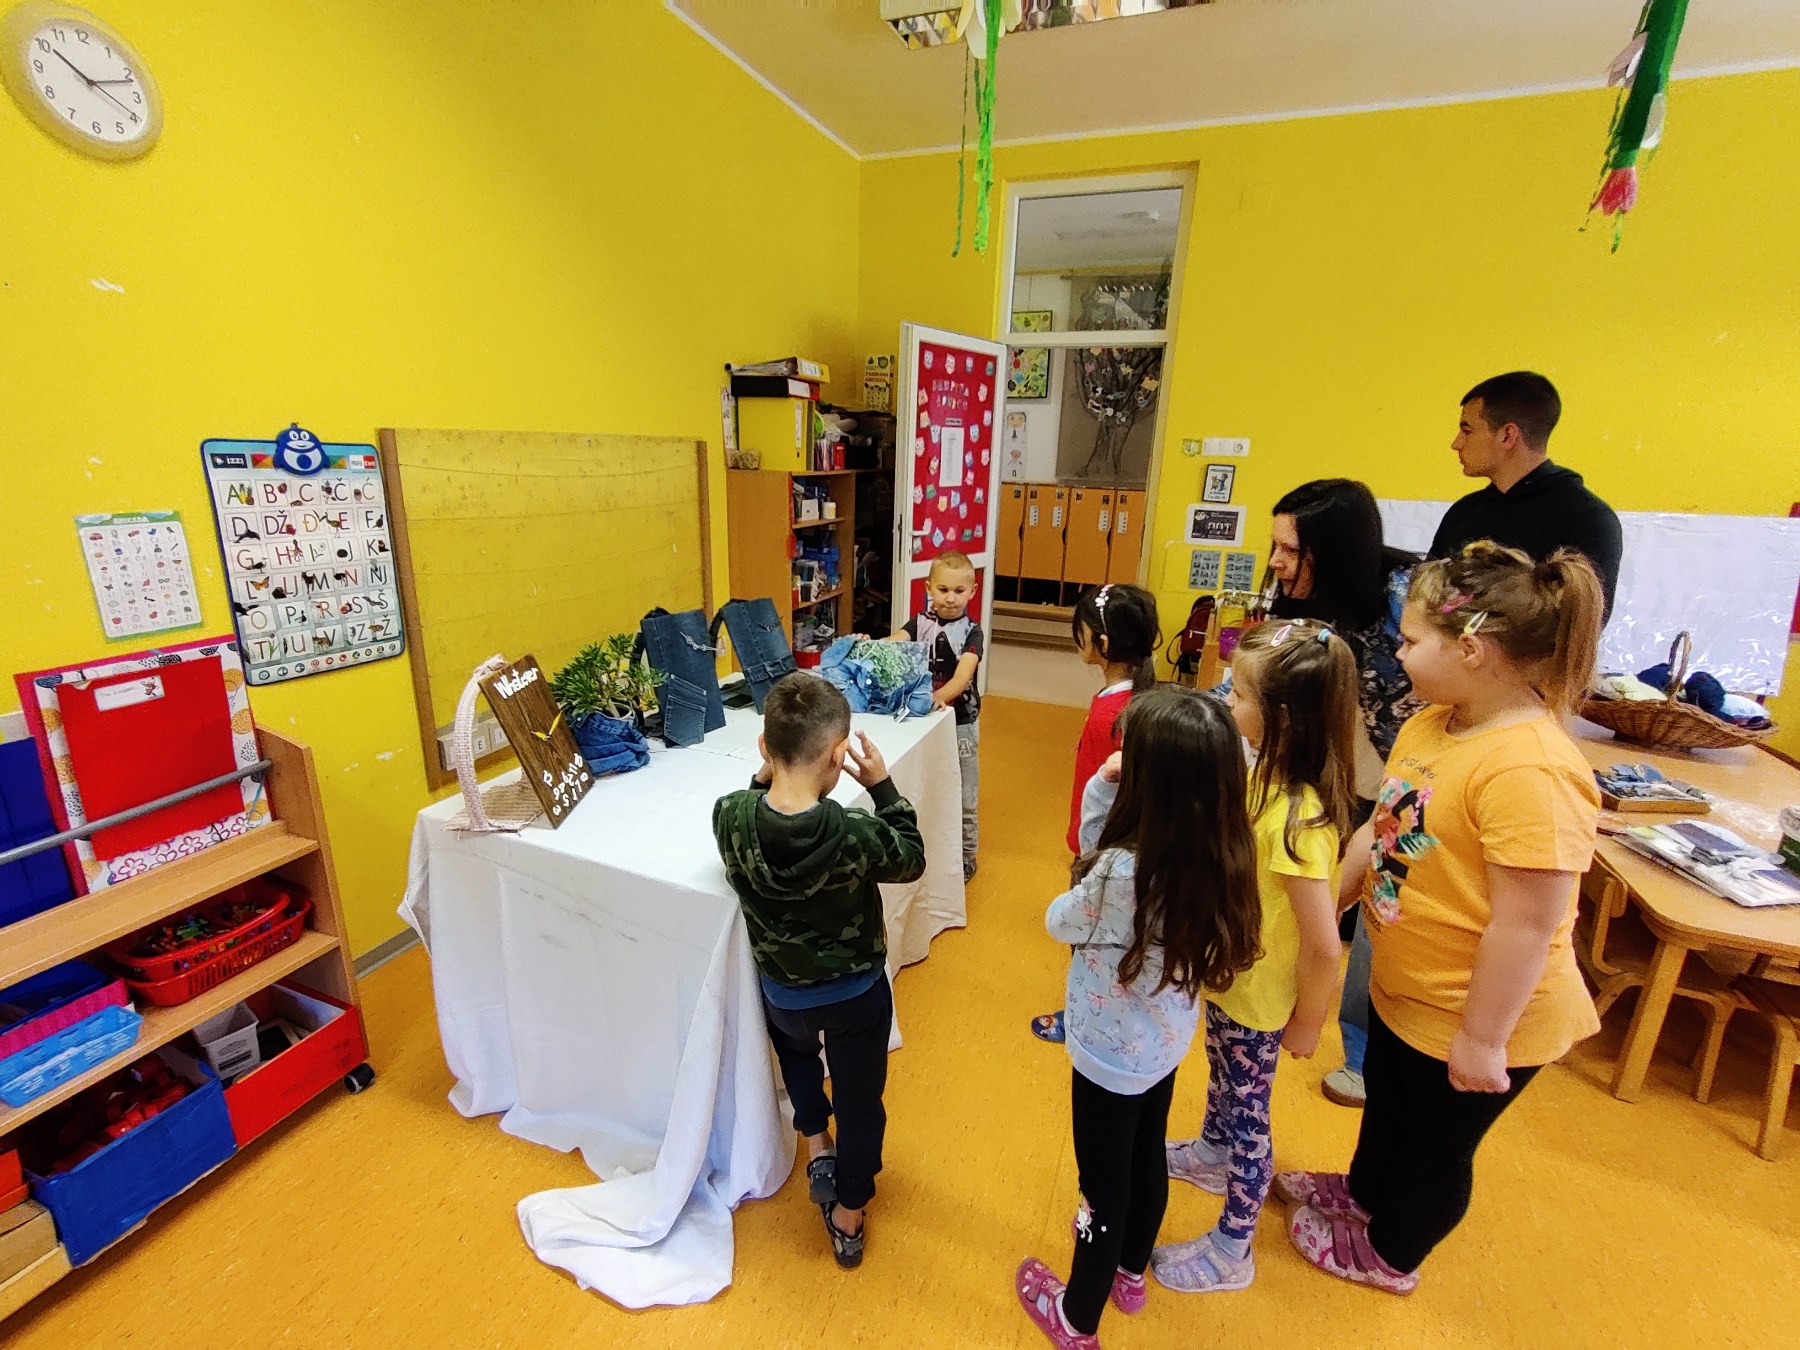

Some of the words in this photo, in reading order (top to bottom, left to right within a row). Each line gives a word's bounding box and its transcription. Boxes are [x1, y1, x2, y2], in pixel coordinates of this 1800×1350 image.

[51, 28, 66, 43] 11
[76, 28, 90, 45] 12
[35, 37, 51, 53] 10
[104, 47, 111, 58] 1
[33, 59, 43, 73] 9
[123, 67, 133, 80] 2
[45, 85, 55, 99] 8
[133, 91, 141, 104] 3
[67, 107, 76, 120] 7
[92, 121, 102, 134] 6
[115, 122, 124, 134] 5
[227, 484, 243, 505] A
[263, 484, 278, 504] B
[300, 484, 313, 503] C
[334, 477, 348, 501] Č
[362, 477, 375, 500] Ć
[232, 516, 248, 537] D
[264, 510, 288, 535] DŽ
[303, 513, 318, 533] Đ
[338, 512, 350, 530] E
[366, 510, 374, 528] F
[236, 549, 254, 570] G
[275, 545, 292, 565] H
[347, 541, 353, 561] J
[367, 539, 379, 556] K
[245, 580, 258, 600] L
[283, 575, 298, 598] LJ
[312, 572, 330, 592] M
[345, 568, 358, 587] N
[371, 565, 387, 585] NJ
[250, 610, 268, 630] O
[285, 605, 296, 624] P
[319, 601, 334, 618] R
[352, 596, 363, 614] S
[377, 588, 388, 610] Š
[254, 640, 267, 660] T
[291, 634, 306, 653] U
[323, 628, 336, 648] V
[356, 624, 368, 642] Z
[382, 614, 393, 637] Ž
[493, 667, 539, 699] Whatever
